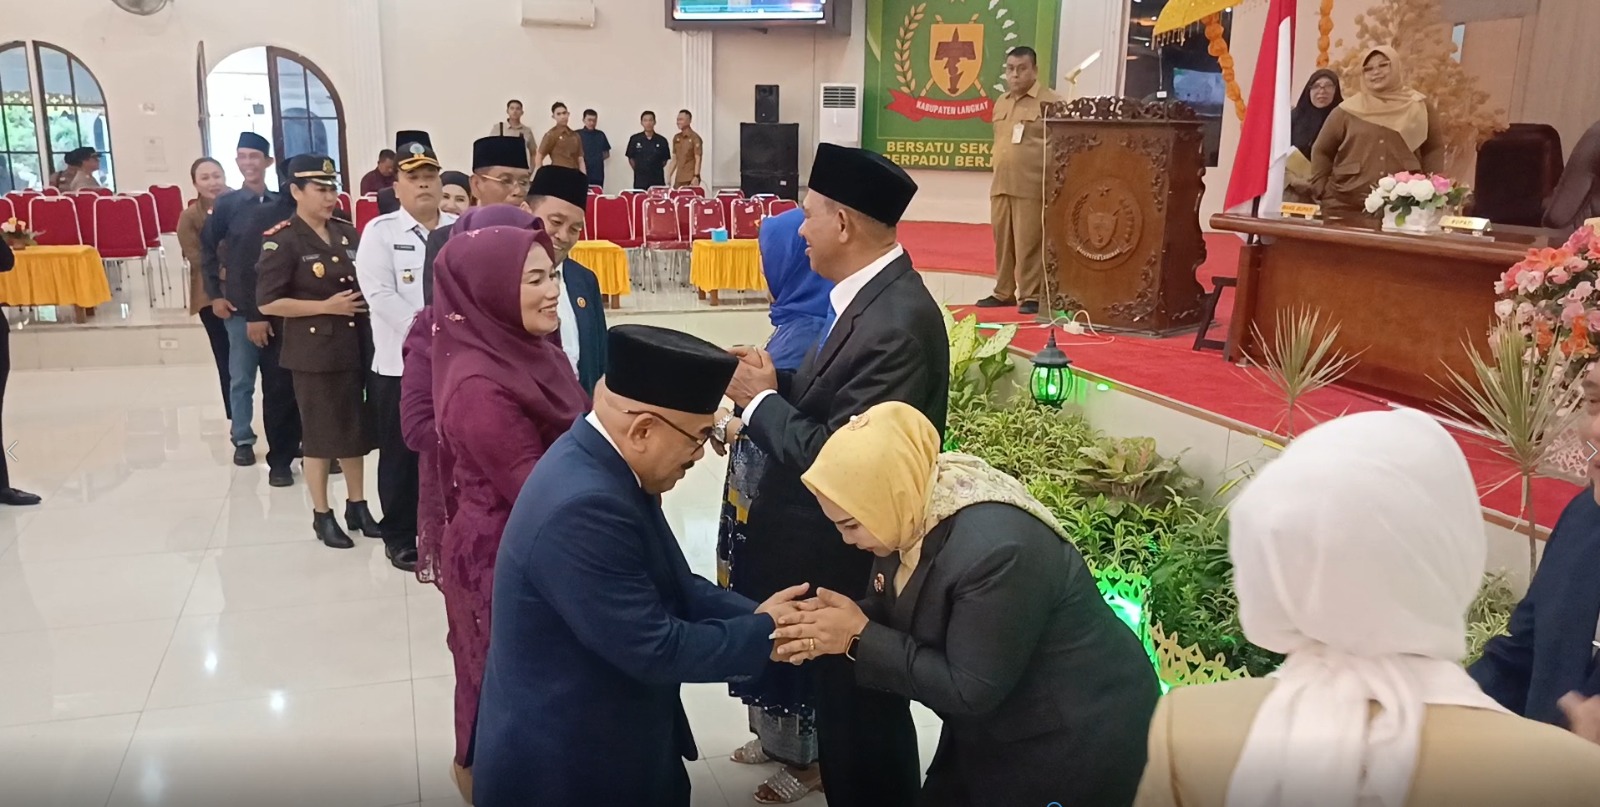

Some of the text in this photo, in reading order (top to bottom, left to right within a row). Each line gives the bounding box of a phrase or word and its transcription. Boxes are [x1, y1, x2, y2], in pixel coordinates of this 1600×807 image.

[916, 100, 989, 115] KABUPATEN LANGKAT
[886, 141, 993, 154] BERSATU SEK
